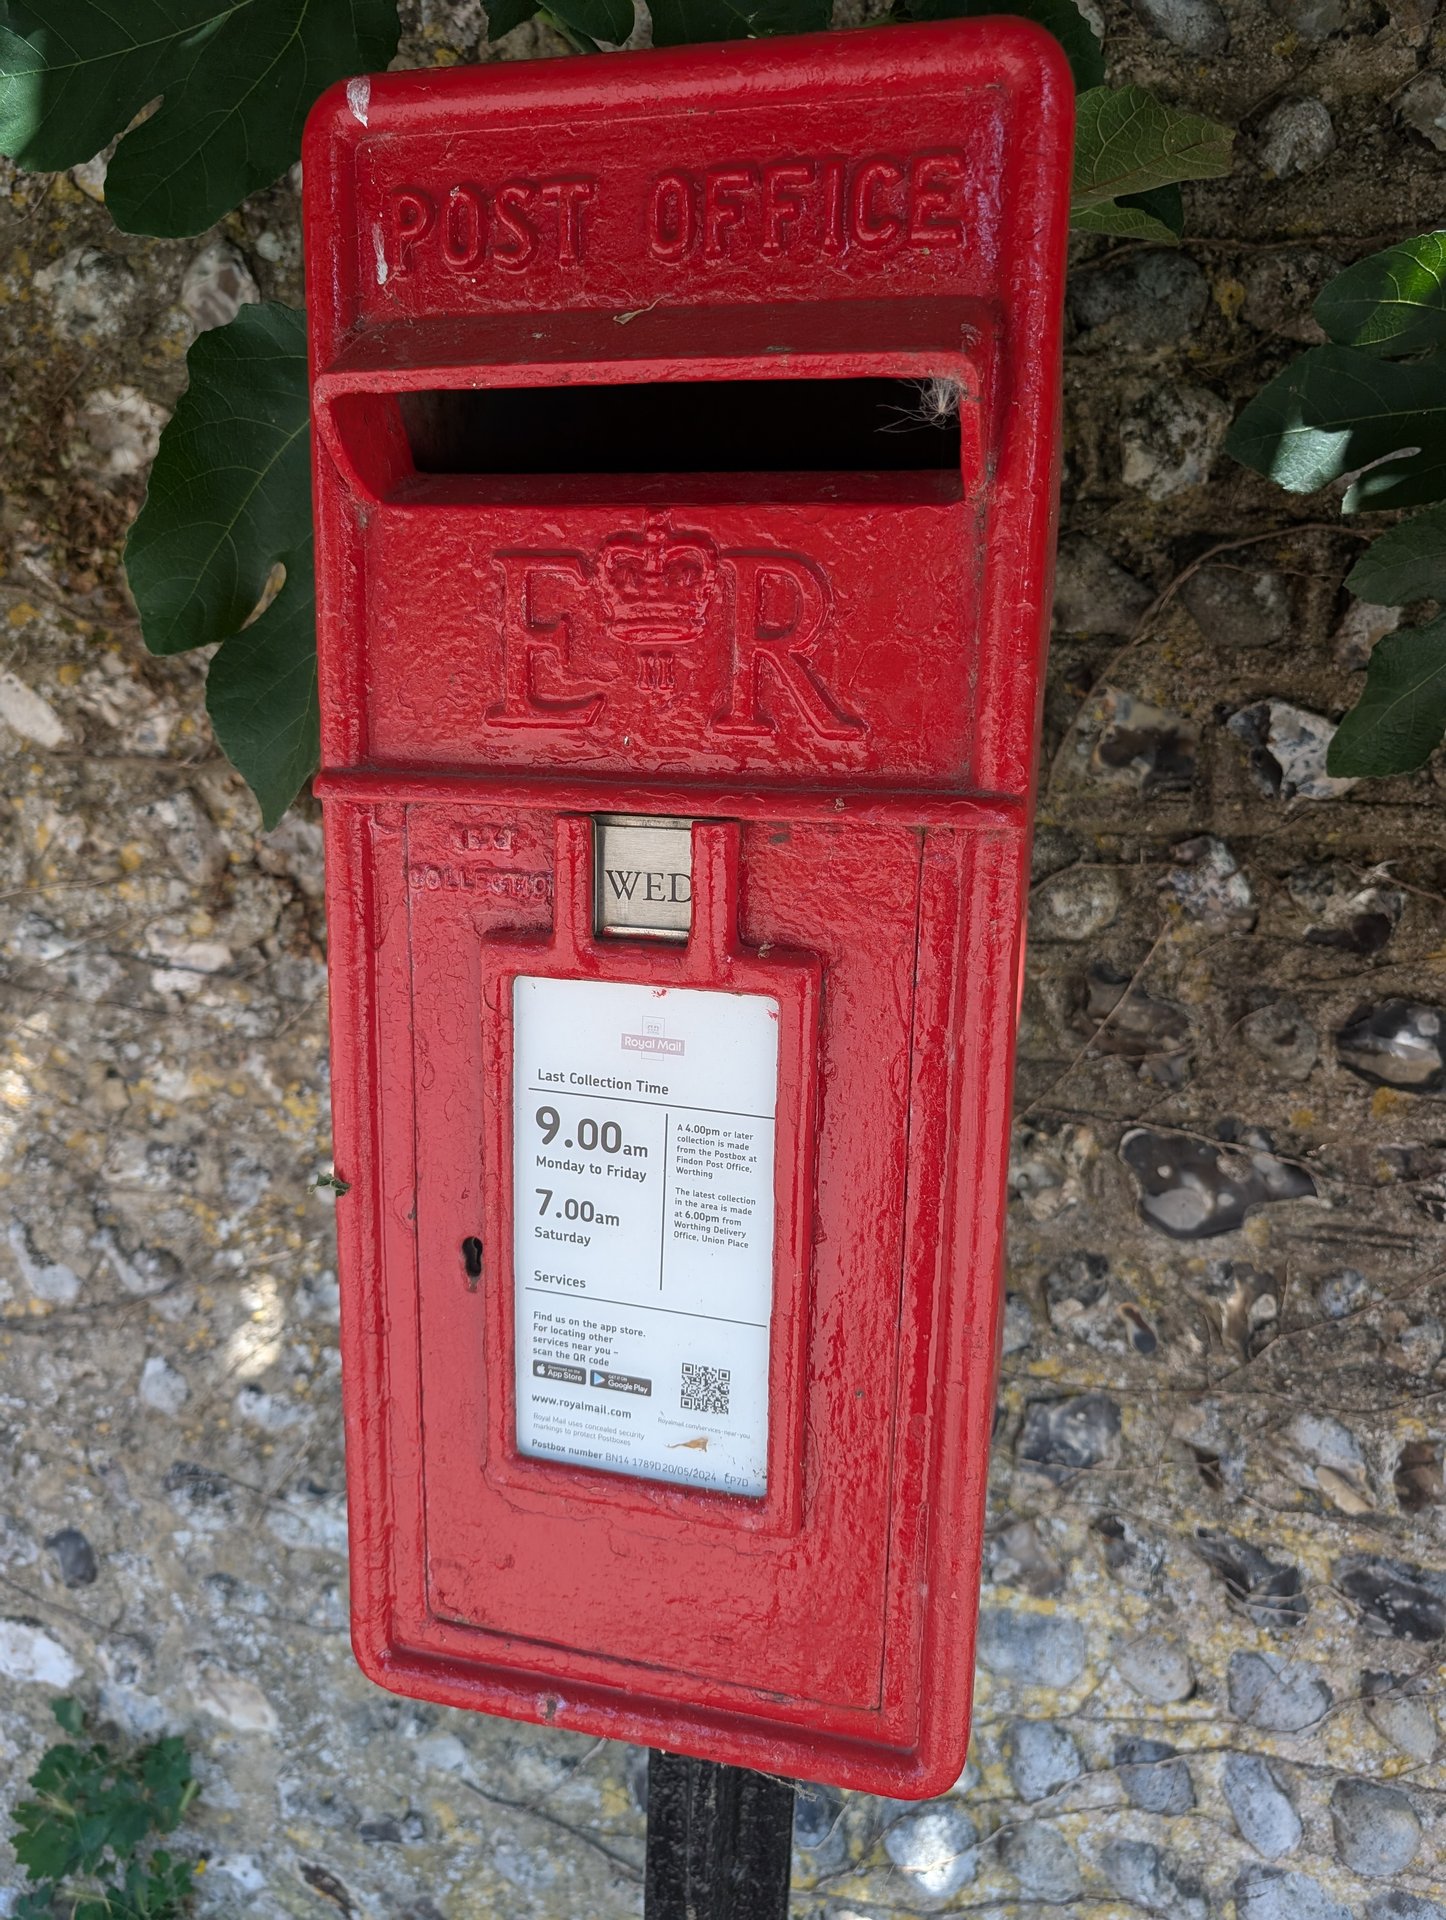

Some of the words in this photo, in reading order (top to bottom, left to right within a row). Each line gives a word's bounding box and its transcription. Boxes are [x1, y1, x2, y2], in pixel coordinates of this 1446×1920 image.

[393, 175, 597, 275] POST
[649, 146, 967, 265] OFFICE
[484, 549, 605, 728] E
[707, 549, 870, 741] R
[605, 869, 693, 903] WED
[624, 1035, 655, 1050] Royal
[657, 1038, 682, 1053] Mail
[538, 1068, 565, 1083] Last
[569, 1072, 632, 1091] Collection
[636, 1080, 669, 1095] Time
[535, 1105, 648, 1158] 9.00am
[685, 1123, 720, 1136] 4.00pm
[734, 1131, 754, 1140] later
[676, 1145, 696, 1154] from
[698, 1148, 712, 1156] the
[714, 1150, 746, 1161] Postbox
[677, 1136, 715, 1146] collection
[717, 1139, 724, 1148] is
[727, 1143, 750, 1151] made
[536, 1155, 585, 1175] Monday
[589, 1163, 602, 1175] to
[606, 1164, 647, 1183] Friday
[676, 1156, 703, 1166] Findon
[706, 1159, 724, 1169] Post
[726, 1162, 752, 1173] Office,
[676, 1166, 713, 1179] Worthing
[675, 1187, 690, 1196] The
[692, 1189, 715, 1200] latest
[717, 1194, 756, 1206] collection
[535, 1188, 620, 1227] 7.00am
[674, 1197, 682, 1205] in
[700, 1203, 718, 1211] area
[730, 1206, 753, 1216] made
[685, 1210, 720, 1223] 6.00pm
[722, 1216, 742, 1226] from
[534, 1227, 591, 1247] Saturday
[673, 1230, 699, 1242] Office,
[701, 1235, 725, 1245] Union
[727, 1238, 749, 1248] Place
[674, 1220, 711, 1233] Worthing
[714, 1226, 746, 1239] Delivery
[534, 1270, 587, 1289] Services
[533, 1311, 552, 1322] Find
[555, 1316, 566, 1324] us
[582, 1319, 598, 1329] the
[600, 1323, 617, 1333] app
[620, 1326, 646, 1338] store.
[533, 1322, 547, 1332] For
[550, 1325, 586, 1340] locating
[588, 1333, 614, 1343] other
[533, 1335, 569, 1348] services
[571, 1342, 592, 1352] near
[594, 1346, 611, 1355] you
[532, 1347, 553, 1357] scan
[555, 1350, 570, 1360] the
[573, 1353, 586, 1363] QR
[588, 1356, 610, 1366] code
[547, 1368, 562, 1378] App
[563, 1372, 582, 1381] Store
[607, 1380, 633, 1391] Google
[633, 1383, 648, 1394] Play
[531, 1394, 632, 1419] www.royalmail.com
[533, 1412, 551, 1422] Royal
[552, 1416, 566, 1424] Mail
[568, 1420, 583, 1428] uses
[585, 1423, 617, 1434] concealed
[619, 1429, 645, 1440] security
[533, 1423, 563, 1433] markings
[564, 1427, 571, 1435] to
[573, 1430, 596, 1439] protect
[597, 1433, 631, 1446] Postboxes
[531, 1438, 566, 1452] Postbox
[568, 1447, 603, 1459] number
[605, 1453, 629, 1464] BN14
